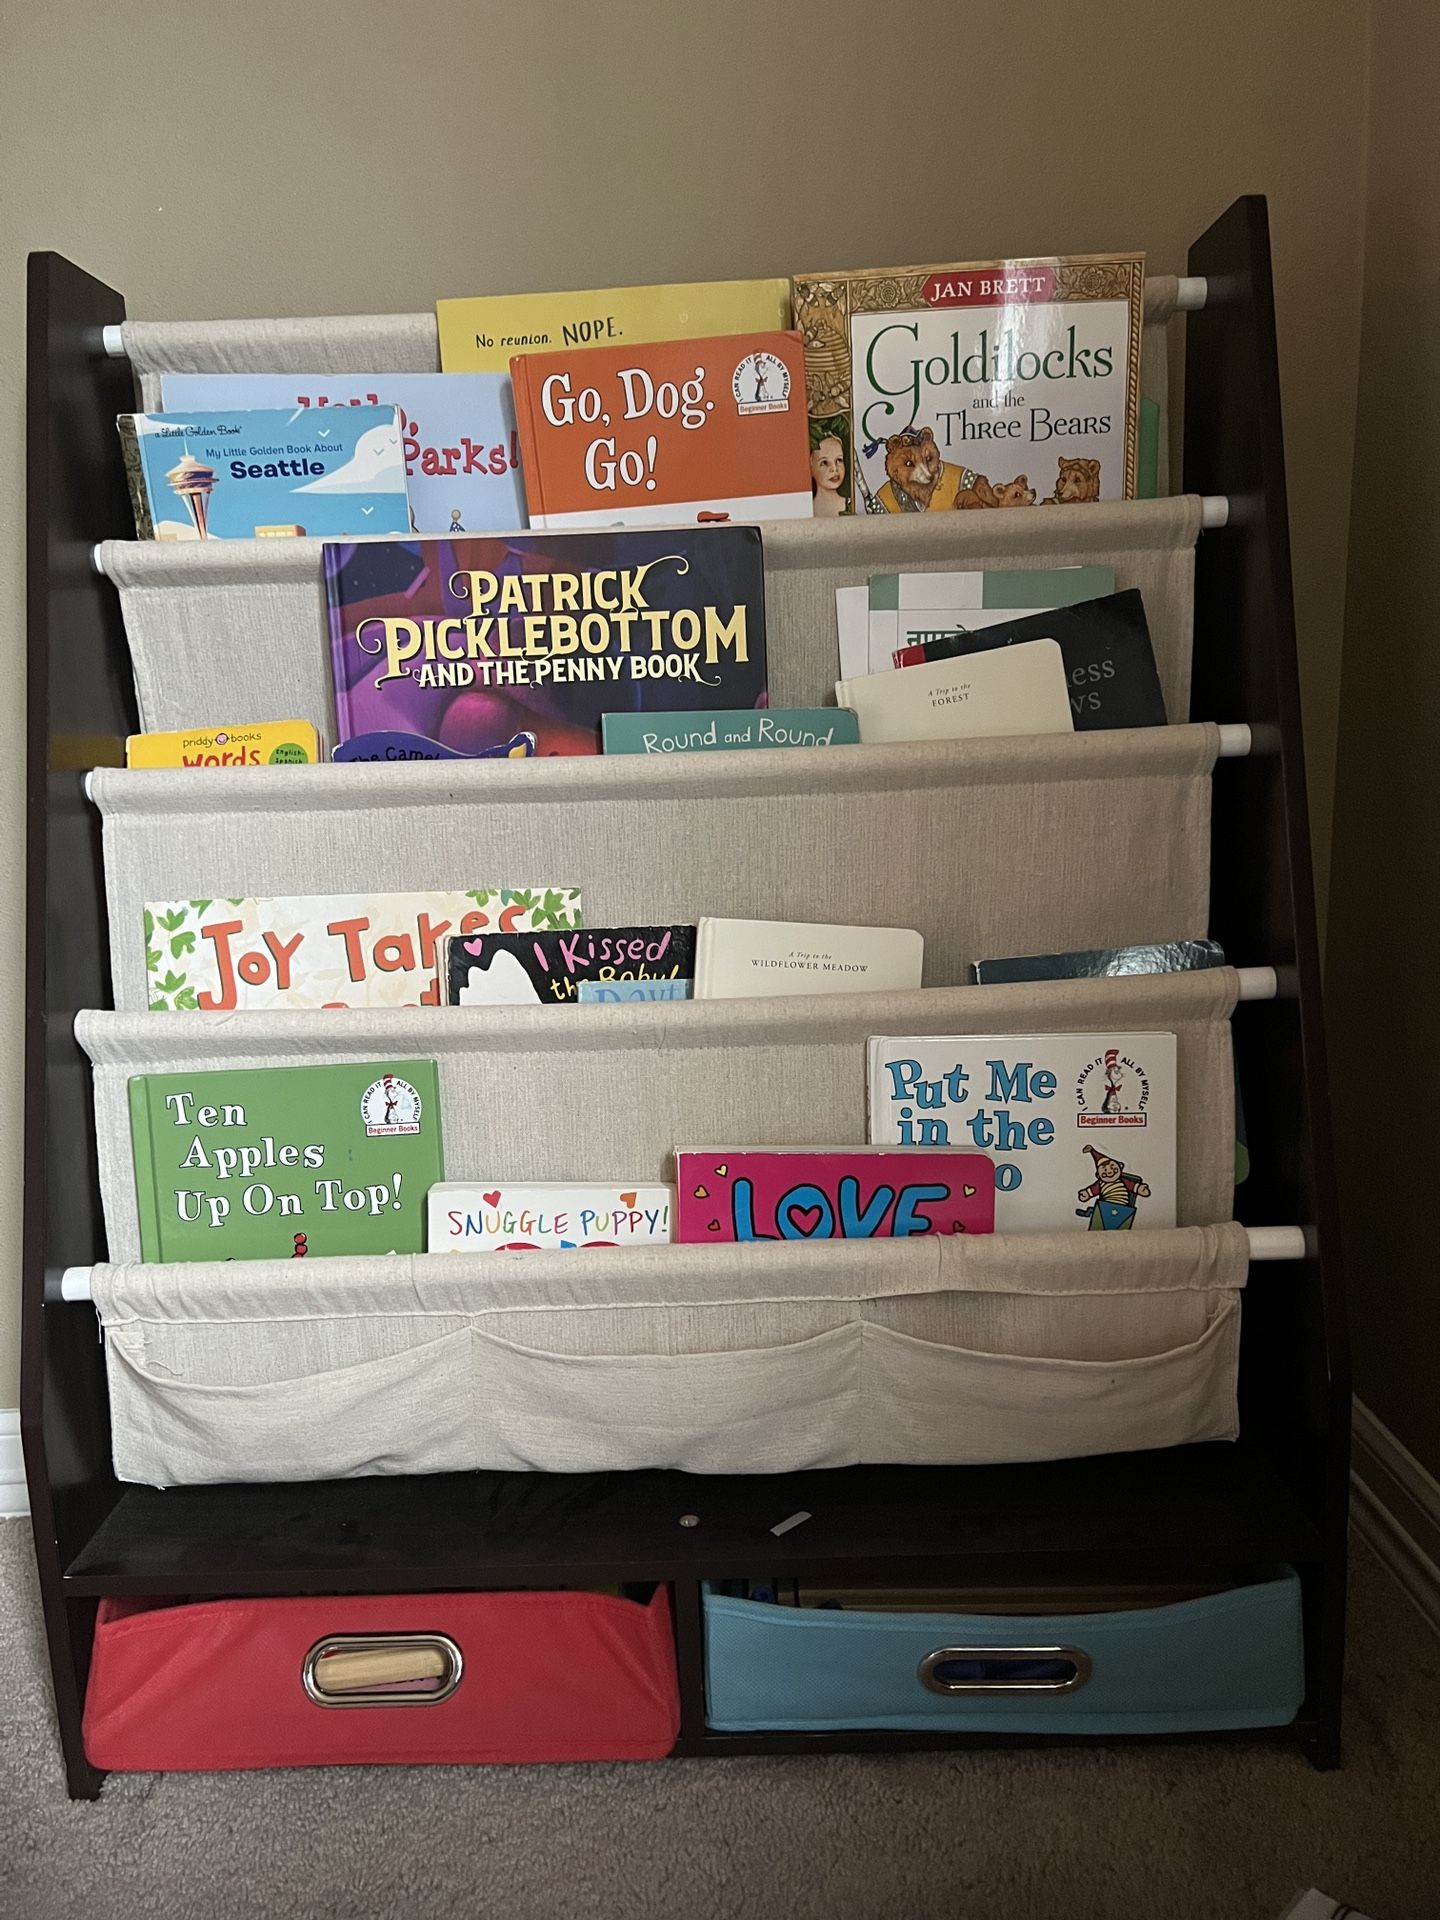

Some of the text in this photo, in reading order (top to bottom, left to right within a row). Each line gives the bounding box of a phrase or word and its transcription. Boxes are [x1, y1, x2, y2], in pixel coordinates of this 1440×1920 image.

[931, 276, 1046, 302] JAN BRETT
[475, 316, 623, 348] No reunion. NOPE.
[862, 322, 1114, 441] Goldilocks
[540, 367, 716, 431] Go, Dog.
[972, 392, 1025, 409] and the
[161, 427, 184, 438] Little
[185, 425, 217, 438] Golden
[936, 408, 1112, 447] Three Bears
[206, 443, 343, 459] My Little Golden Book About
[584, 435, 657, 491] Go!
[230, 458, 325, 479] Seattle
[449, 555, 689, 618] PATRICK
[356, 604, 748, 688] PICKLEBOTTOM
[412, 652, 721, 689] AND THE PENNY BOOK
[932, 693, 969, 707] FOREST
[183, 733, 262, 748] priddy books
[643, 718, 834, 753] Round and Round
[182, 746, 261, 767] words
[533, 931, 672, 973] I Kissed
[751, 959, 869, 973] WILDFLOWER MEADOW
[797, 951, 811, 960] Trip
[1078, 1063, 1094, 1084] READ
[1095, 1057, 1103, 1066] IT
[1120, 1057, 1135, 1069] ALL
[1135, 1067, 1146, 1077] BY
[363, 1087, 375, 1103] READ
[396, 1080, 407, 1089] ALL
[408, 1087, 416, 1096] BY
[413, 1096, 421, 1120] MYSELF
[885, 1059, 1058, 1110] Put Me
[1076, 1088, 1085, 1105] CAN
[1138, 1079, 1149, 1111] MYSELF
[165, 1091, 248, 1128] Ten
[1080, 1115, 1143, 1125] Beginner Books
[368, 1124, 418, 1134] Beginner Books
[897, 1106, 1056, 1151] in the
[178, 1135, 326, 1180] Apples
[174, 1172, 403, 1228] Up On Top!
[731, 1175, 951, 1244] LOVE
[448, 1205, 669, 1236] SNUGGLE PUPPY!
